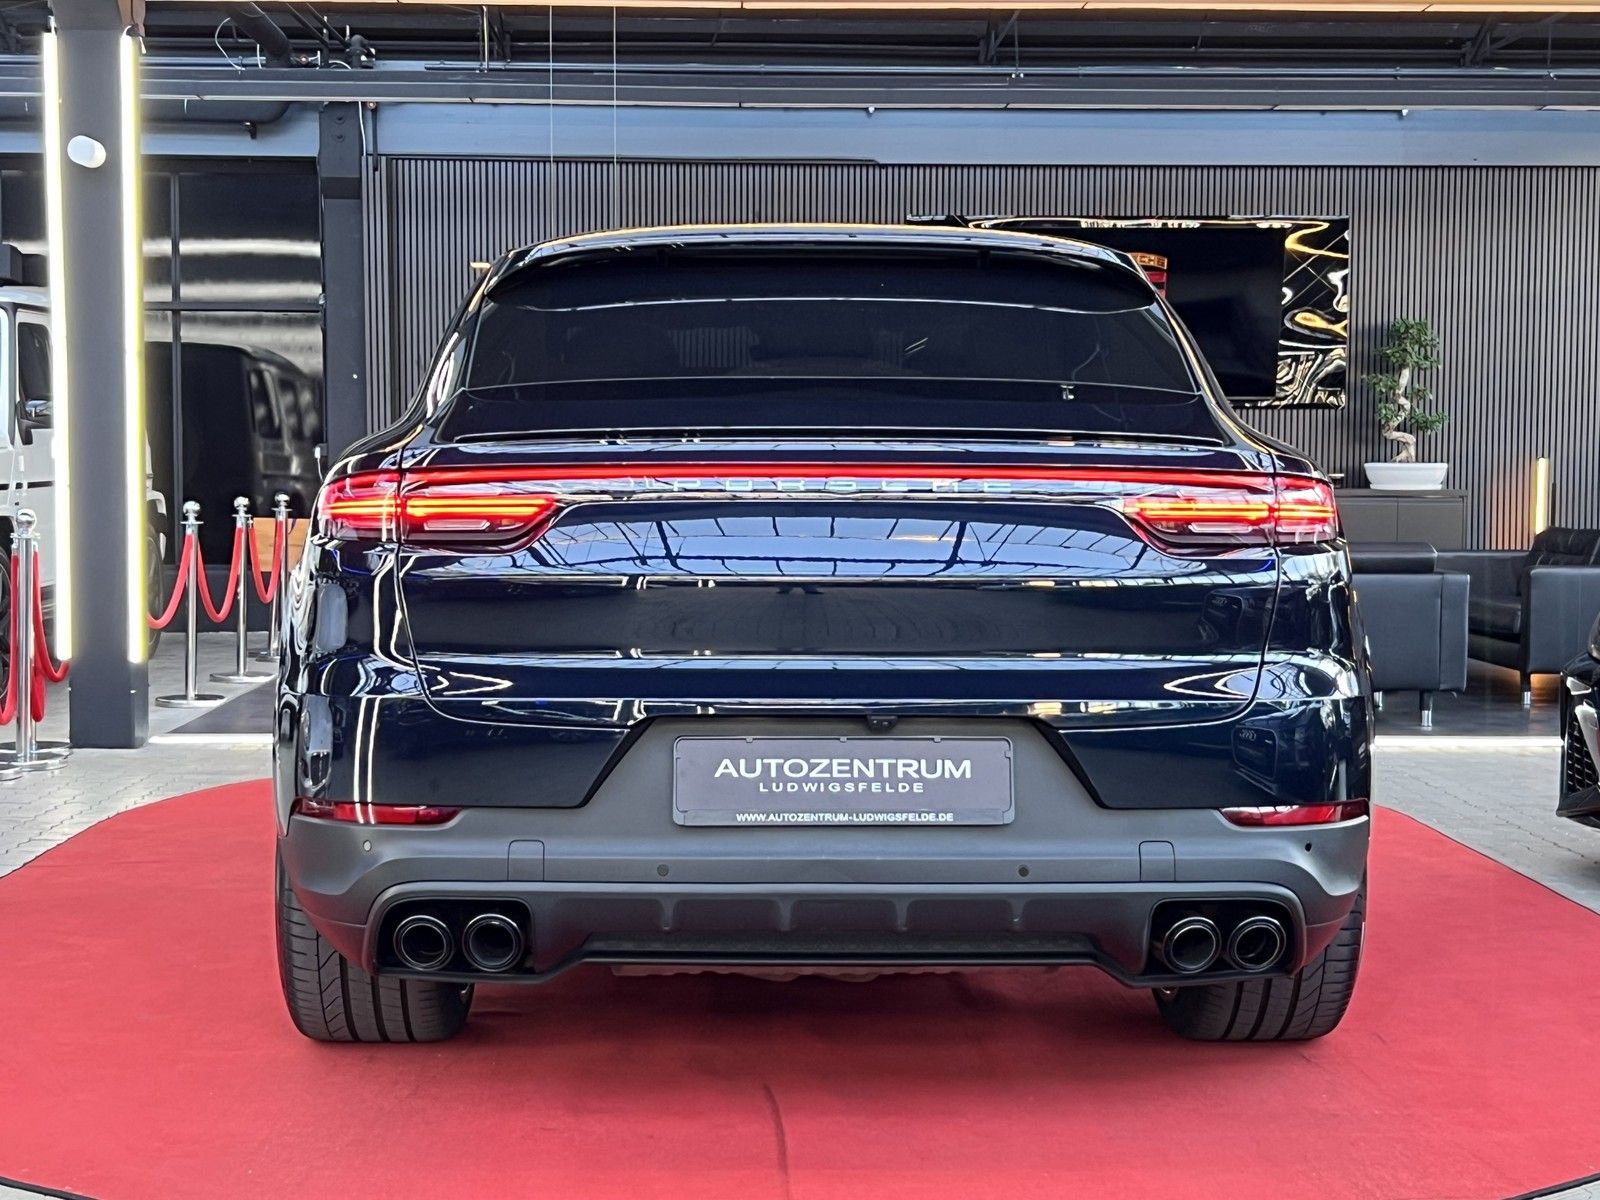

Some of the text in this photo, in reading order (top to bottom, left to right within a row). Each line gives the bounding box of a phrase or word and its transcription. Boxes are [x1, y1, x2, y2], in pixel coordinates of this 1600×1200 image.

[673, 478, 1012, 493] PORSCHE
[714, 758, 972, 779] AUTOZENTRUM
[759, 782, 924, 793] LUDWIGSFELDE
[736, 812, 954, 822] WWW.AUTOZENTRUM-LUDWIGSFELDE.DE
